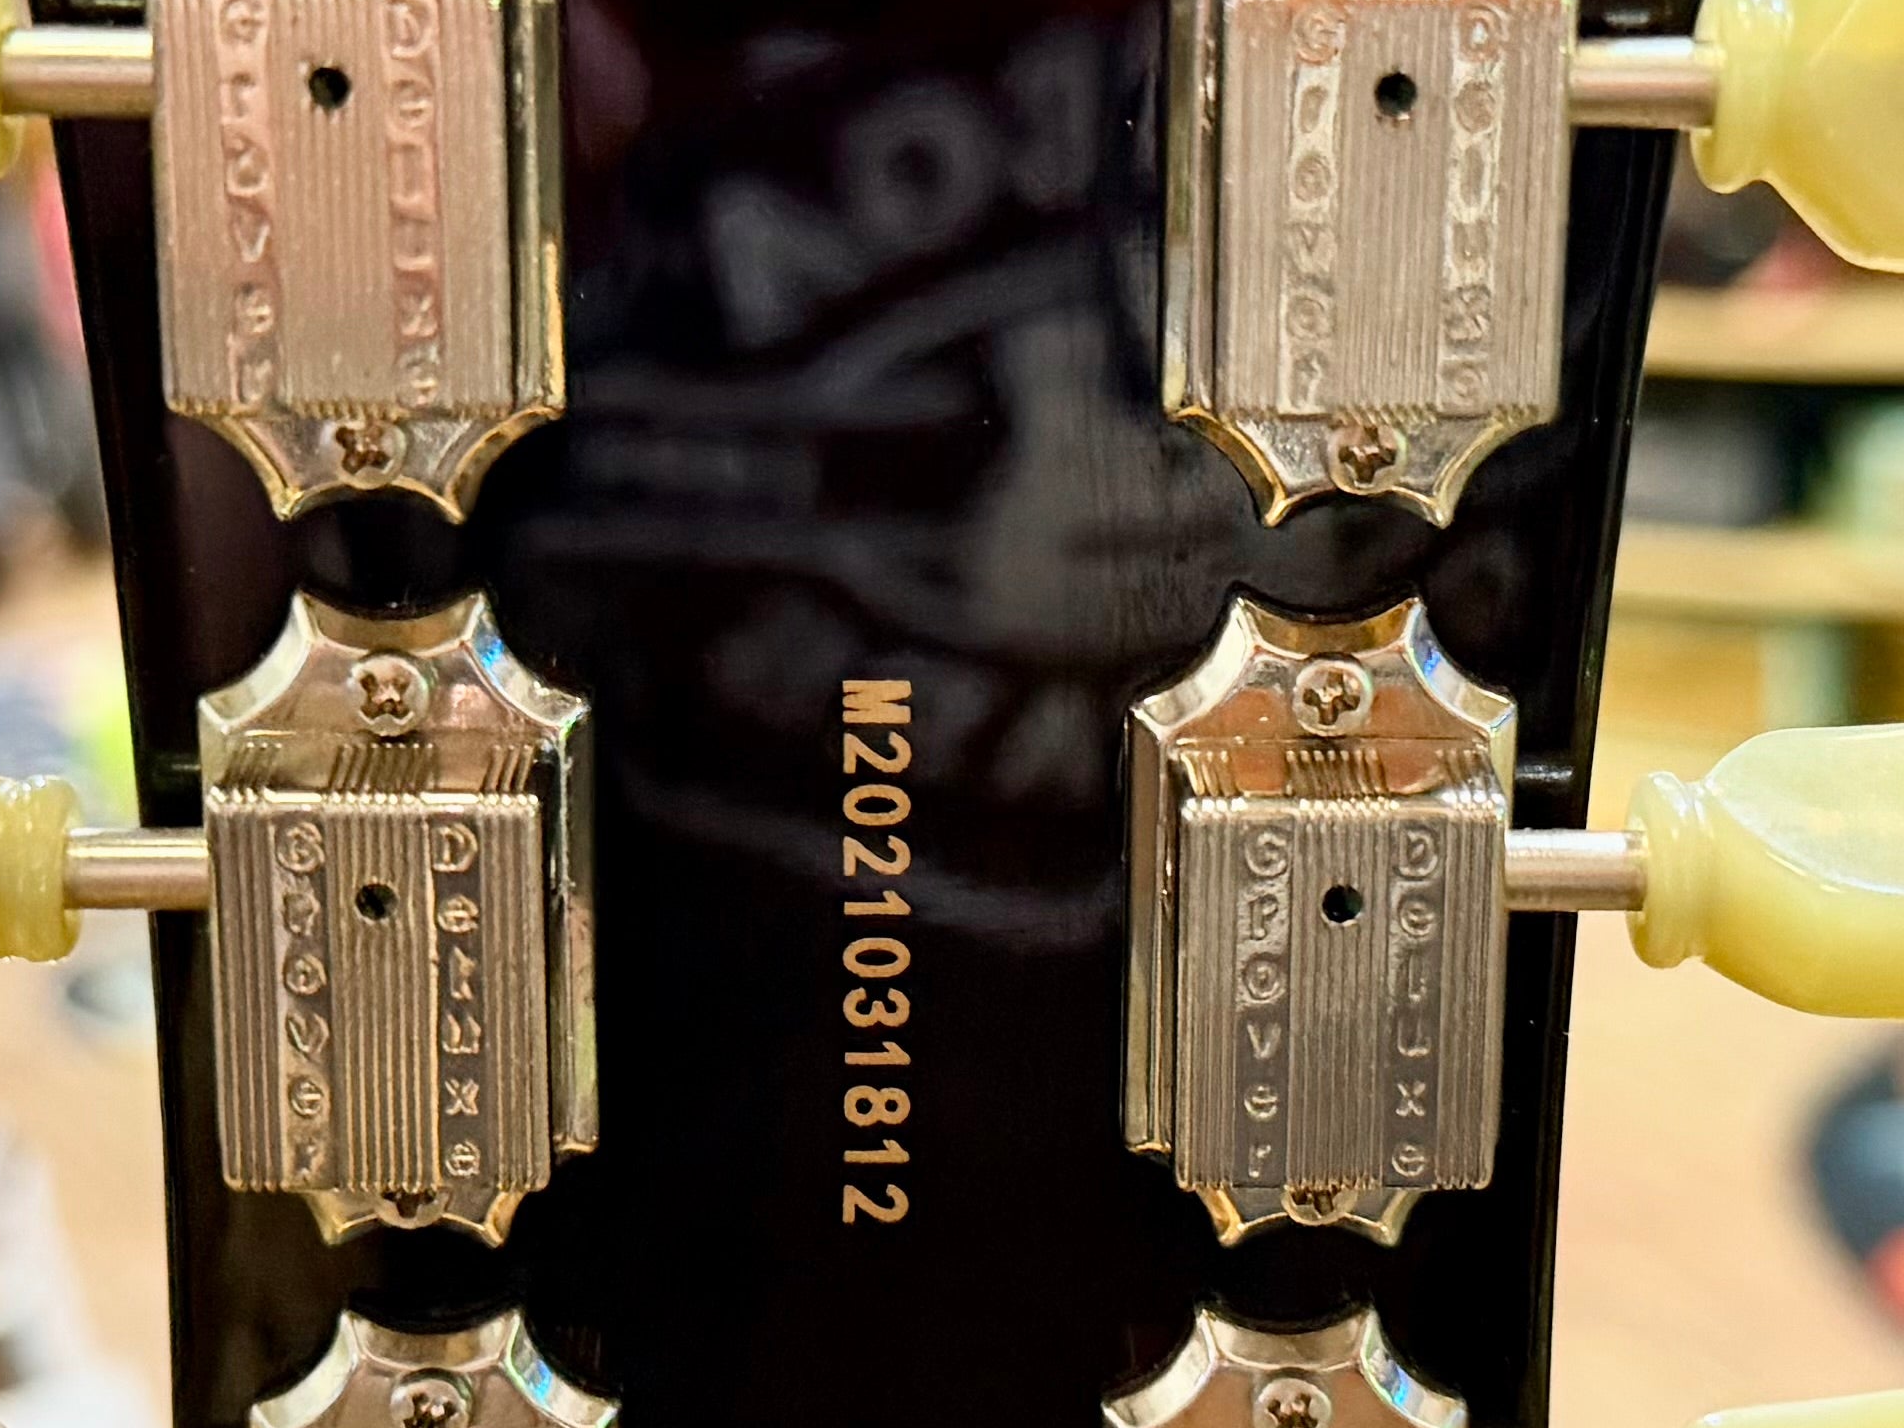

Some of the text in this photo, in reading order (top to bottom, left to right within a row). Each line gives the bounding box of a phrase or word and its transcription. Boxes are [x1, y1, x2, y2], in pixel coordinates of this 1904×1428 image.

[431, 822, 481, 1177] Deluxe
[841, 678, 913, 1225] M2021031812
[1390, 825, 1439, 1177] Deluxe
